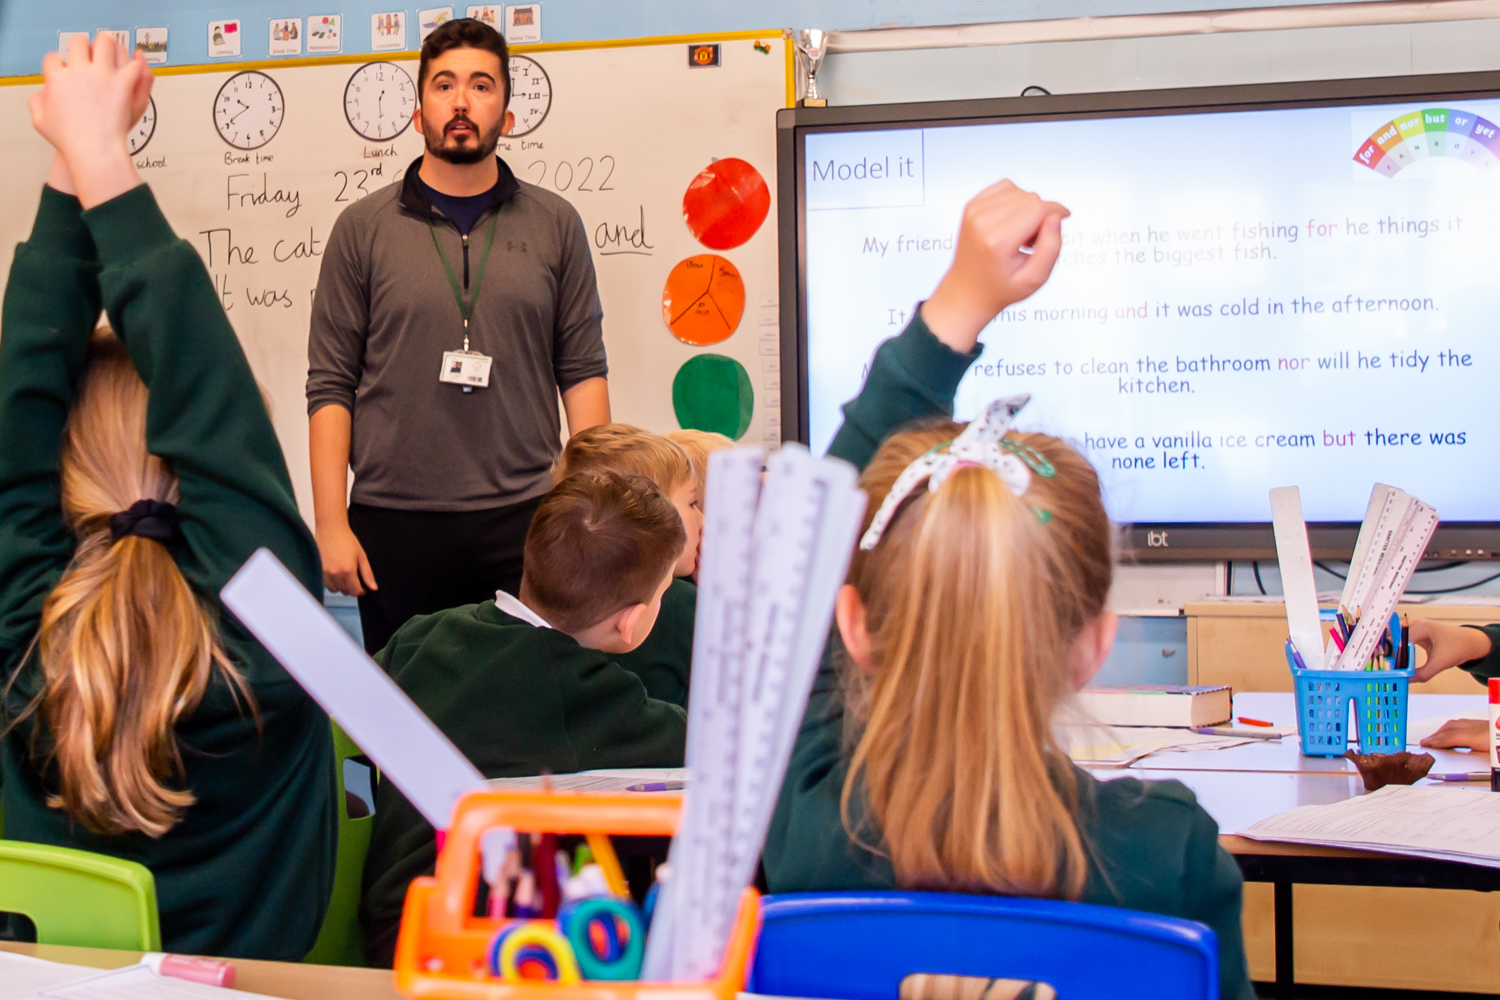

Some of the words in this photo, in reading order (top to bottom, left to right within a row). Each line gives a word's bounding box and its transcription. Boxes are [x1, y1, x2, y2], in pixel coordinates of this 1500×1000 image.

[1400, 118, 1420, 131] nor
[1425, 114, 1445, 124] but
[1455, 117, 1468, 126] or
[1377, 126, 1397, 145] and
[1475, 124, 1494, 138] yet
[364, 144, 397, 159] Lunch
[521, 140, 544, 150] time
[136, 157, 167, 168] school
[224, 152, 250, 165] Break
[256, 152, 274, 164] time
[1359, 146, 1374, 164] for
[528, 155, 615, 191] 2022
[812, 156, 889, 181] Model
[900, 157, 914, 178] it
[228, 173, 302, 217] Friday
[595, 205, 654, 248] and
[862, 237, 889, 257] My
[897, 233, 953, 252] friend
[1093, 227, 1140, 244] when
[1148, 225, 1168, 243] he
[1177, 225, 1222, 241] went
[1233, 221, 1298, 243] fishing
[1306, 218, 1337, 237] for
[1347, 218, 1370, 236] he
[1378, 216, 1439, 238] things
[1449, 215, 1462, 232] it
[199, 229, 258, 267] The
[274, 227, 322, 262] cat
[1115, 248, 1146, 263] the
[1154, 245, 1224, 266] biggest
[1233, 242, 1277, 260] fish.
[247, 288, 292, 307] was
[888, 308, 906, 325] It
[1034, 303, 1107, 324] morning
[1115, 301, 1148, 318] and
[1156, 298, 1170, 317] it
[1178, 302, 1212, 317] was
[1220, 298, 1259, 316] cold
[1268, 297, 1283, 314] in
[1291, 296, 1325, 314] the
[1332, 295, 1439, 313] afternoon.
[974, 359, 1046, 376] refuses
[1055, 360, 1072, 375] to
[1080, 358, 1128, 374] clean
[1137, 356, 1168, 373] the
[1177, 355, 1271, 373] bathroom
[1278, 356, 1310, 371] nor
[1318, 351, 1349, 369] will
[1359, 350, 1382, 368] he
[1390, 349, 1429, 373] tidy
[1438, 348, 1473, 367] the
[1118, 376, 1195, 394] kitchen.
[1085, 432, 1128, 449] have
[1135, 437, 1145, 449] a
[1153, 430, 1212, 448] vanilla
[1220, 432, 1247, 447] ice
[1255, 434, 1315, 447] cream
[1323, 429, 1356, 446] but
[1364, 428, 1422, 446] there
[1430, 431, 1466, 445] was
[1112, 457, 1155, 469] none
[1163, 451, 1205, 469] left.
